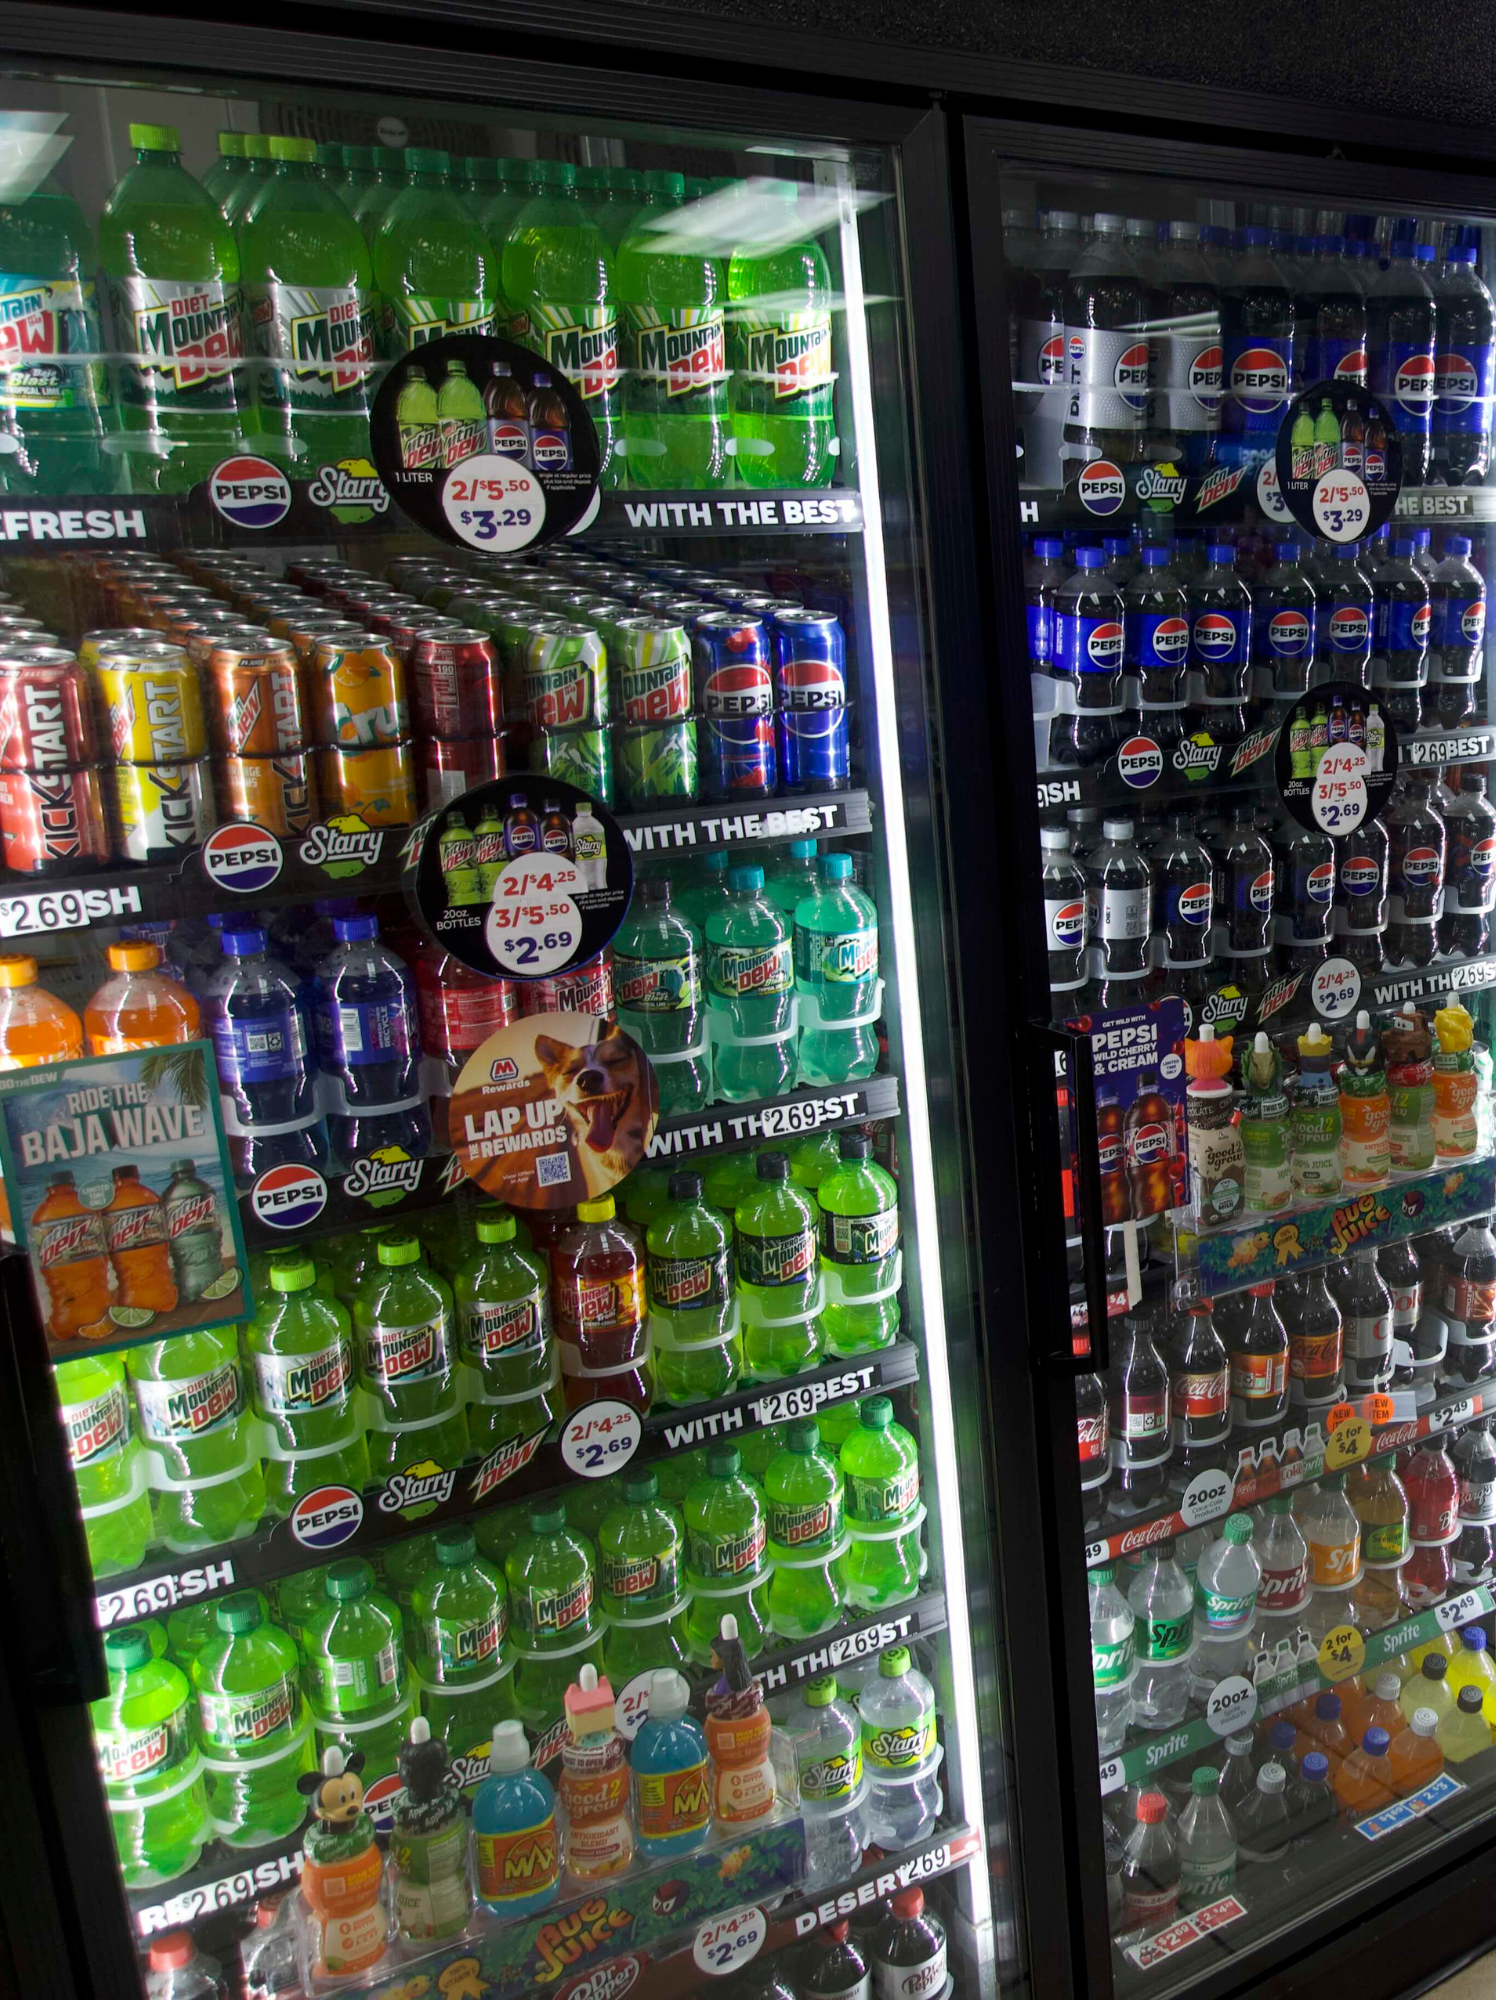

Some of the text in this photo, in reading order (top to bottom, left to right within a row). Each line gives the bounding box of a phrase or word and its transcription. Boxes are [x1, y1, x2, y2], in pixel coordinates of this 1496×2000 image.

[1233, 372, 1287, 389] PEPSI
[495, 439, 527, 448] PEPSI
[536, 449, 567, 458] PEPSI
[403, 472, 433, 483] LITER
[1081, 482, 1123, 494] PEPSI
[1136, 468, 1187, 504] Starry
[1291, 481, 1309, 490] LITER
[216, 485, 288, 500] PEPSI
[309, 463, 391, 514] Starry
[451, 479, 531, 501] 2/$5.50
[1319, 487, 1364, 503] 2/$5.50
[624, 499, 857, 527] WITH THE BEST
[1423, 496, 1468, 516] BEST
[460, 509, 532, 540] $3.29
[1323, 509, 1363, 533] $3.29
[1195, 629, 1234, 642] PEPSI
[1271, 626, 1309, 639] PEPSI
[1331, 622, 1367, 635] PEPSI
[1156, 634, 1188, 645] PEPSI
[777, 690, 843, 708] PEPSI
[1173, 740, 1222, 771] Starry
[1414, 742, 1447, 763] $2.69
[1448, 735, 1490, 757] BEST
[1120, 756, 1161, 769] PEPSI
[1323, 757, 1365, 775] 2/$4.25
[1283, 786, 1310, 797] BOTTLES
[1318, 780, 1362, 799] 3/$5.50
[1320, 803, 1360, 827] $2.69
[512, 834, 535, 842] PEPSI
[623, 805, 838, 852] WITH THE BEST
[300, 826, 385, 865] Starry
[575, 838, 602, 854] Starry
[210, 847, 278, 867] PEPSI
[1404, 859, 1439, 872] PEPSI
[503, 870, 576, 897] 2/$4.25
[1342, 869, 1379, 882] PEPSI
[0, 894, 82, 932] $2.69
[495, 903, 570, 928] 3/$5.50
[436, 917, 482, 931] BOTTLES
[504, 931, 572, 965] $2.69
[1317, 968, 1356, 990] 2/$4.25
[1454, 967, 1485, 988] $2.69
[1319, 989, 1355, 1011] $2.69
[1374, 978, 1423, 1005] WITH
[1102, 1014, 1146, 1028] GET WILD WITH
[1202, 996, 1248, 1026] Starry
[1092, 1023, 1158, 1053] PEPSI
[1094, 1042, 1158, 1063] WILD CHERRY
[1163, 1059, 1180, 1067] LIMITED
[1094, 1051, 1159, 1076] & CREAM
[31, 1072, 58, 1085] DEW
[482, 1079, 531, 1096] Rewards
[66, 1082, 149, 1115] RIDE THE
[464, 1098, 564, 1142] LAP UP
[764, 1109, 817, 1134] $2.69
[21, 1104, 206, 1168] BAJA WAVE
[481, 1125, 568, 1159] REWARDS
[644, 1120, 724, 1159] WITH
[1136, 1137, 1166, 1150] PEPSI
[1298, 1134, 1333, 1147] grow
[469, 1143, 480, 1161] THE
[1214, 1152, 1243, 1172] grow
[1311, 1158, 1333, 1169] JUICE
[344, 1159, 424, 1197] Starry
[82, 1185, 110, 1194] LIMITED
[89, 1191, 105, 1199] TIME
[258, 1184, 324, 1209] PEPSI
[1218, 1202, 1234, 1211] MILK
[1332, 1194, 1376, 1228] BUG
[1330, 1205, 1392, 1255] JUICE
[1109, 1291, 1126, 1305] $4
[813, 1366, 875, 1402] BEST
[763, 1389, 815, 1420] $2.69
[1333, 1409, 1351, 1420] NEW
[571, 1413, 632, 1443] 2/$4.25
[663, 1411, 743, 1449] WITH
[1335, 1426, 1363, 1444] 2 for
[575, 1436, 632, 1469] $2.69
[1339, 1438, 1358, 1455] $4
[1280, 1462, 1303, 1480] Coke
[379, 1469, 456, 1512] Starry
[1188, 1483, 1227, 1507] 20oz
[297, 1503, 358, 1531] PEPSI
[1191, 1498, 1223, 1515] Coca-Cola
[1194, 1505, 1221, 1520] Products
[1207, 1595, 1254, 1612] Sprite
[832, 1627, 881, 1662] $2.69
[1325, 1632, 1354, 1650] 2 for
[1383, 1623, 1421, 1653] Sprite
[1331, 1643, 1353, 1664] $4
[1211, 1687, 1249, 1713] 20oz
[1220, 1709, 1247, 1727] Products
[1223, 1706, 1240, 1718] Sprite
[871, 1725, 930, 1757] Starry
[1146, 1733, 1190, 1766] Sprite
[577, 1756, 604, 1767] TO OPEN
[802, 1752, 859, 1790] Starry
[1422, 1791, 1435, 1801] 2
[408, 1803, 428, 1819] Apple
[574, 1797, 619, 1819] grow
[570, 1825, 619, 1839] ANTIOXIDANT
[581, 1838, 607, 1848] BLEND
[504, 1844, 556, 1880] MAX
[536, 1898, 608, 1951] BUG
[701, 1910, 756, 1948] 2/$4.25
[534, 1907, 636, 1983] JUICE
[707, 1930, 758, 1967] $2.69
[590, 1965, 616, 1991] Dr
[901, 1957, 947, 1996] Pepper
[921, 1961, 938, 1983] Dr
